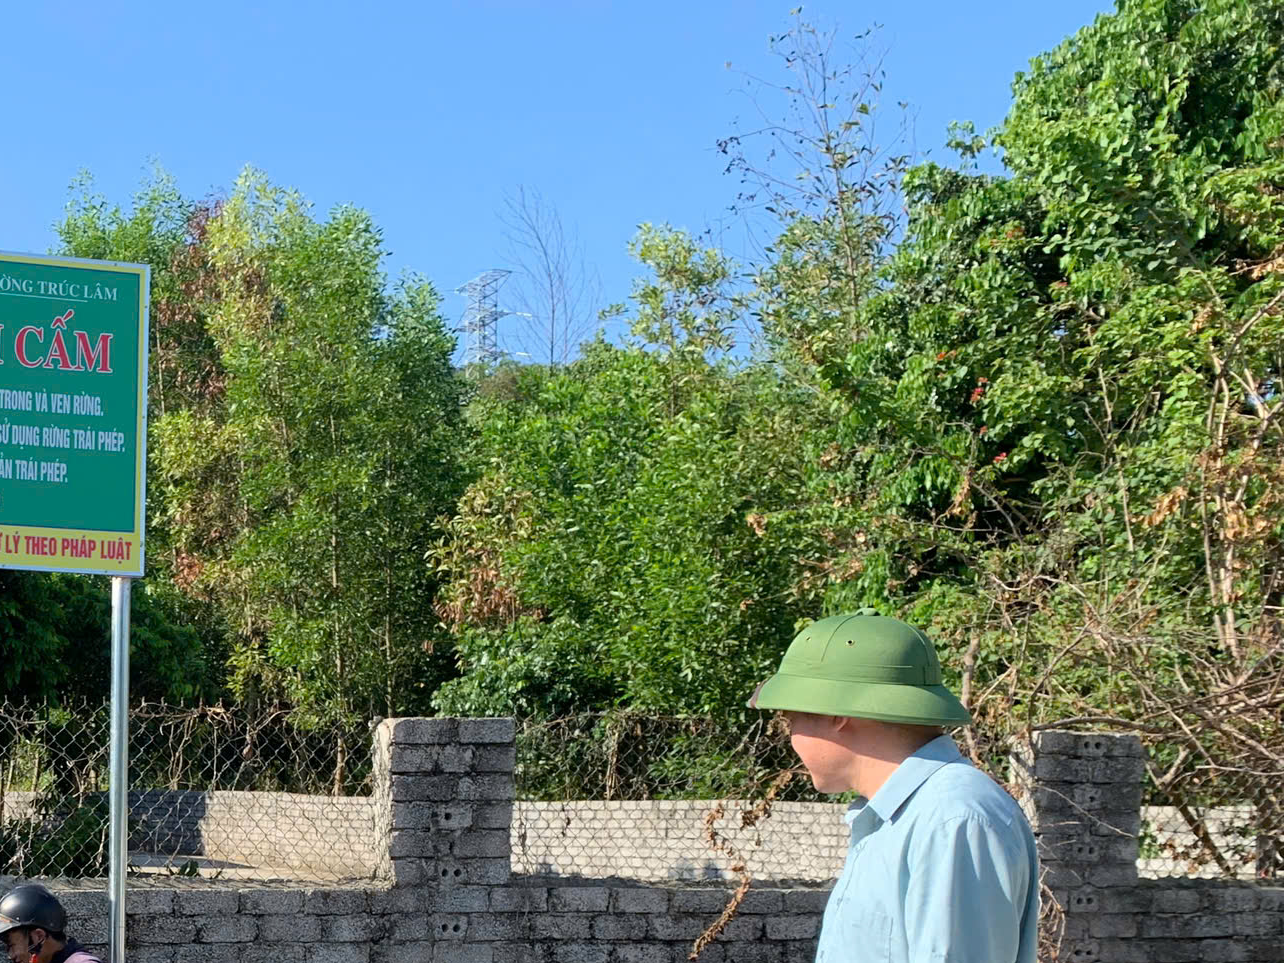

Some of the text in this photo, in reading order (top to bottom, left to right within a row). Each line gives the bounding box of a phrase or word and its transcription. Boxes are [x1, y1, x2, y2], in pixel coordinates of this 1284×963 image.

[37, 280, 80, 297] TRÚC
[83, 282, 117, 301] LÂM
[14, 309, 113, 373] CẤM
[0, 389, 33, 411] TRONG
[35, 388, 48, 413] VÀ
[51, 393, 71, 414] VEN
[73, 391, 104, 416] RỪNG.
[11, 424, 39, 449] DỤNG
[42, 424, 70, 449] RỪNG
[73, 426, 95, 450] TRÁI
[98, 428, 126, 452] PHÉP.
[15, 457, 38, 481] TRÁI
[40, 458, 68, 483] PHÉP.
[5, 531, 21, 554] LÝ
[24, 535, 58, 557] THEO
[61, 535, 96, 558] PHÁP
[100, 537, 133, 564] LUẬT
